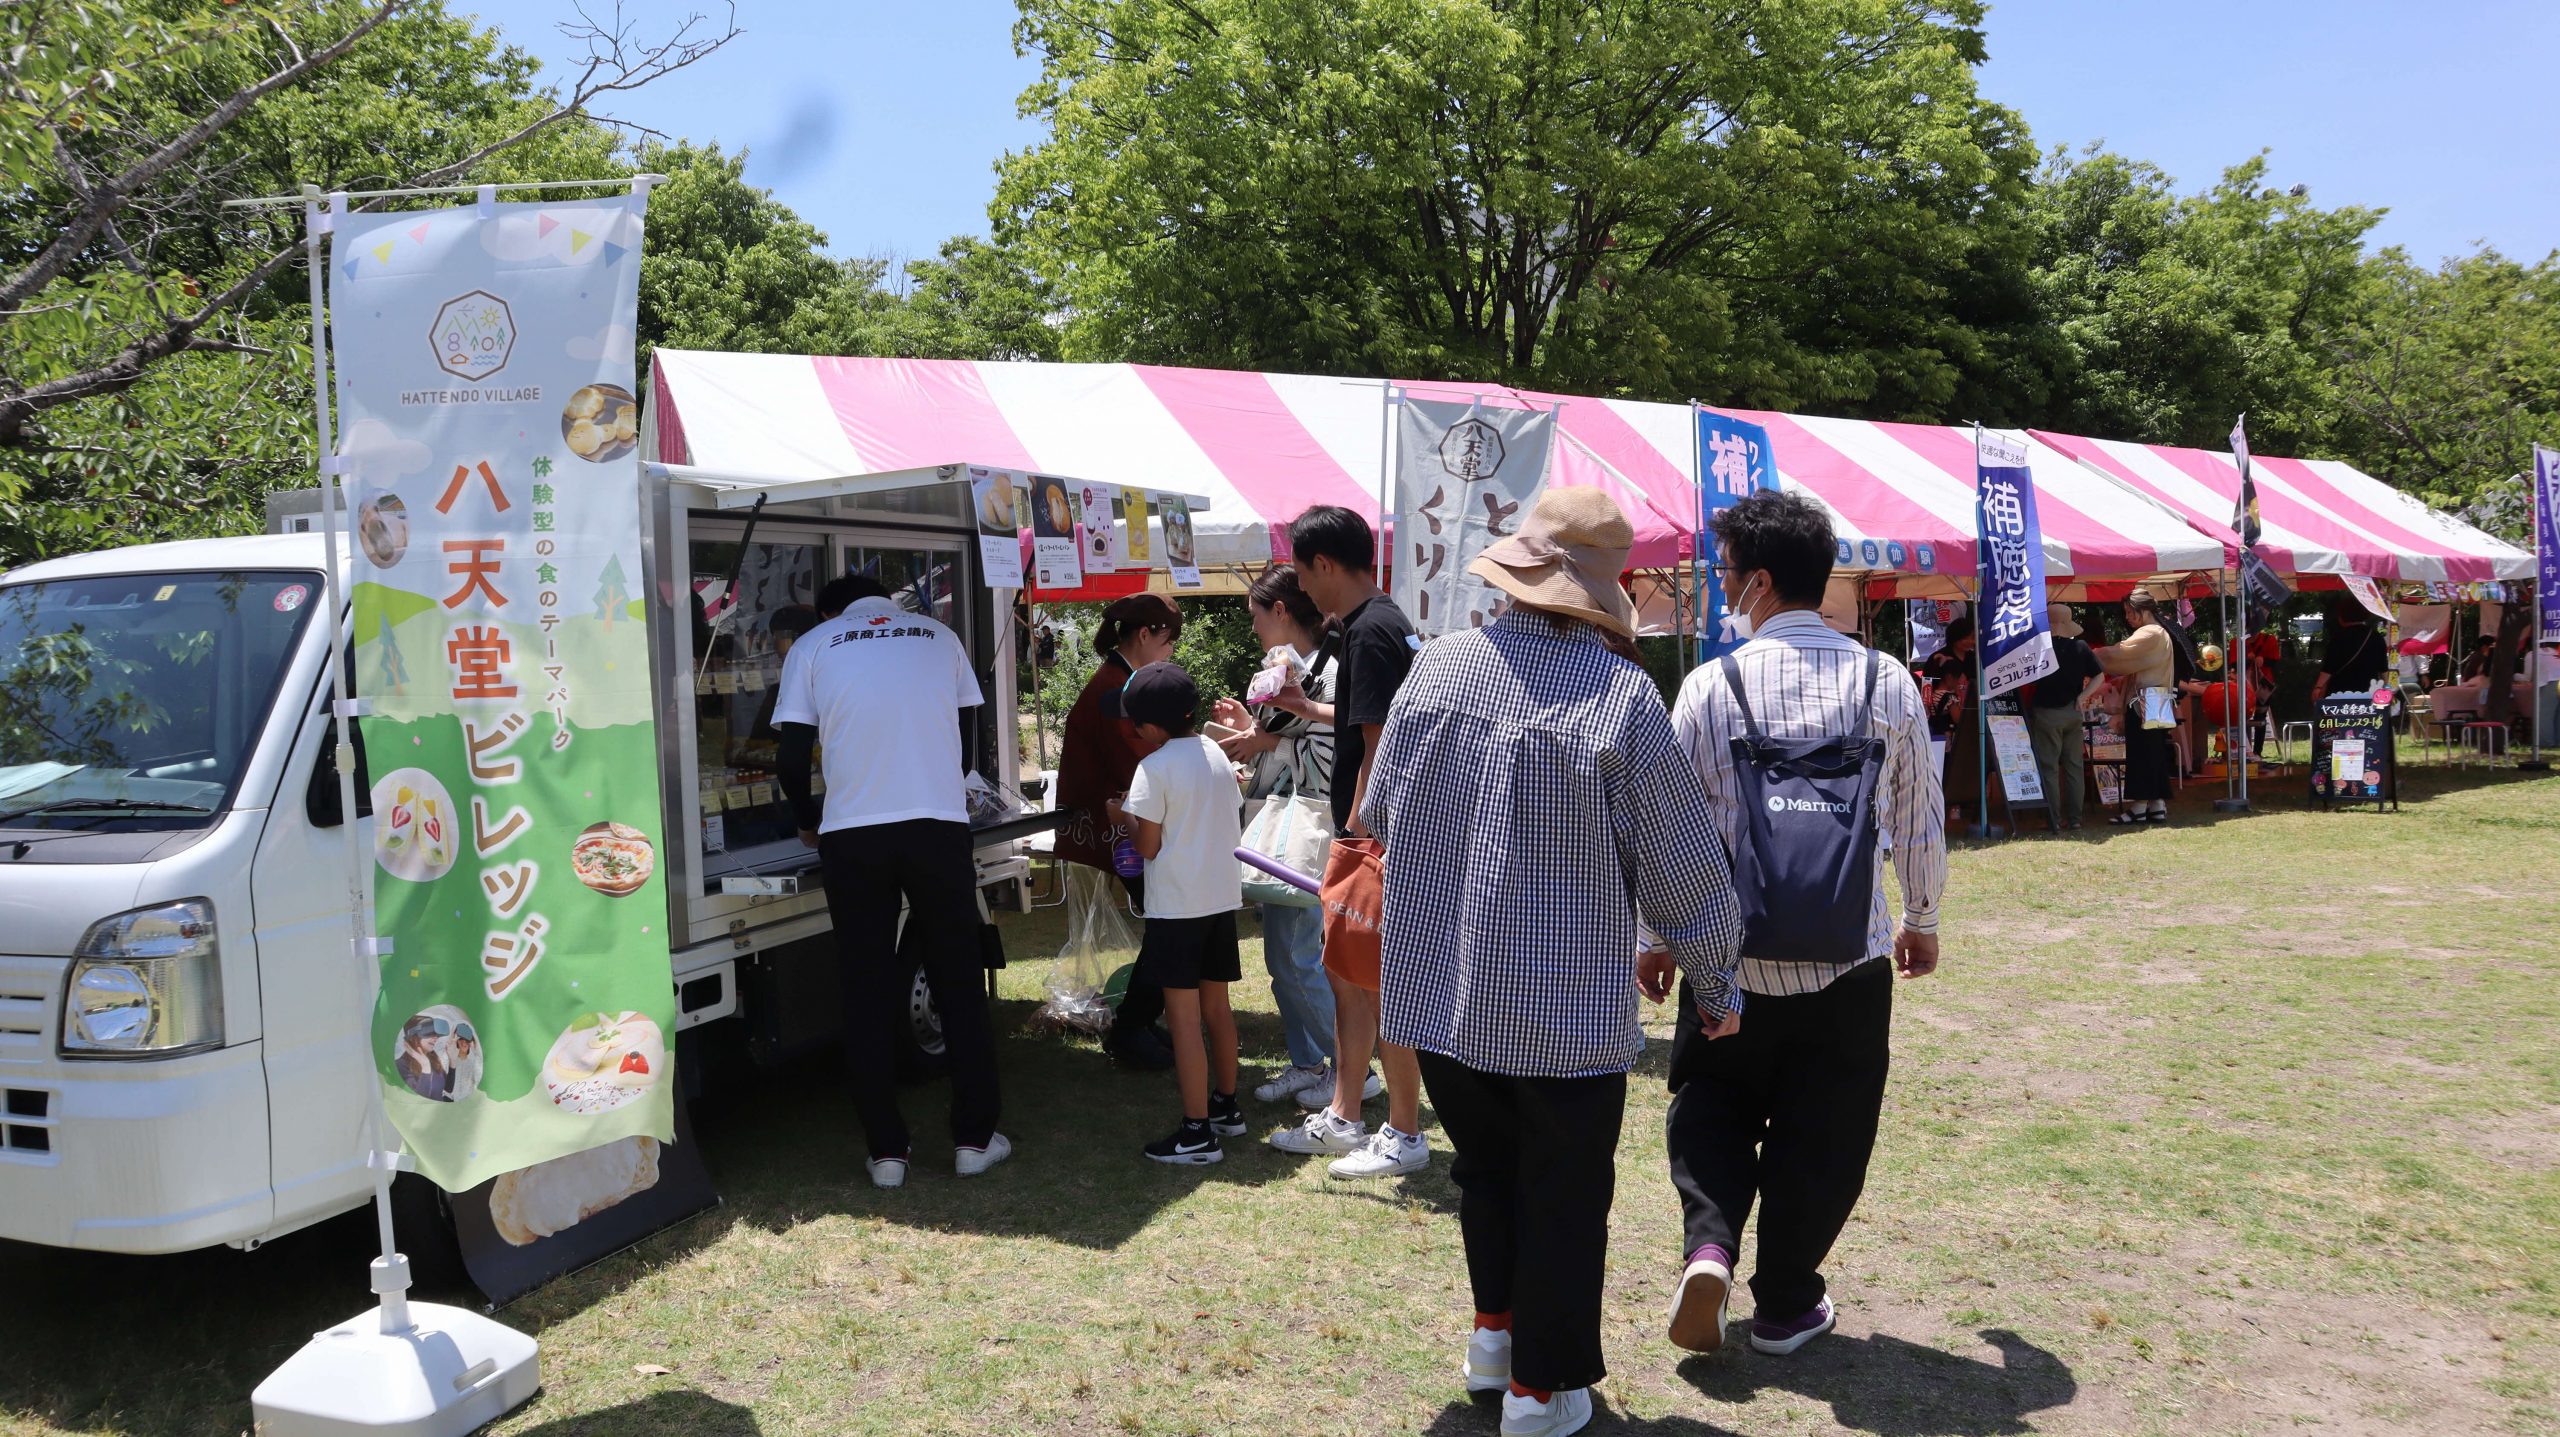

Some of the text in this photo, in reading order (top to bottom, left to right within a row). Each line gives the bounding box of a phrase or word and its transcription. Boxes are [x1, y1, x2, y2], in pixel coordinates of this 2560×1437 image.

[401, 387, 541, 405] HATTENDO VILLAGE
[1461, 423, 1487, 482] 八天堂
[1981, 475, 2034, 648] 補聴器
[531, 455, 571, 750] 体験型の食のテーマパーク
[829, 627, 936, 649] 三原商工会議所
[1996, 661, 2017, 674] since
[434, 459, 544, 998] 八天堂ビレッジ
[1786, 798, 1852, 814] Marmot
[1328, 900, 1364, 924] DEAN
[1365, 917, 1374, 929] &
